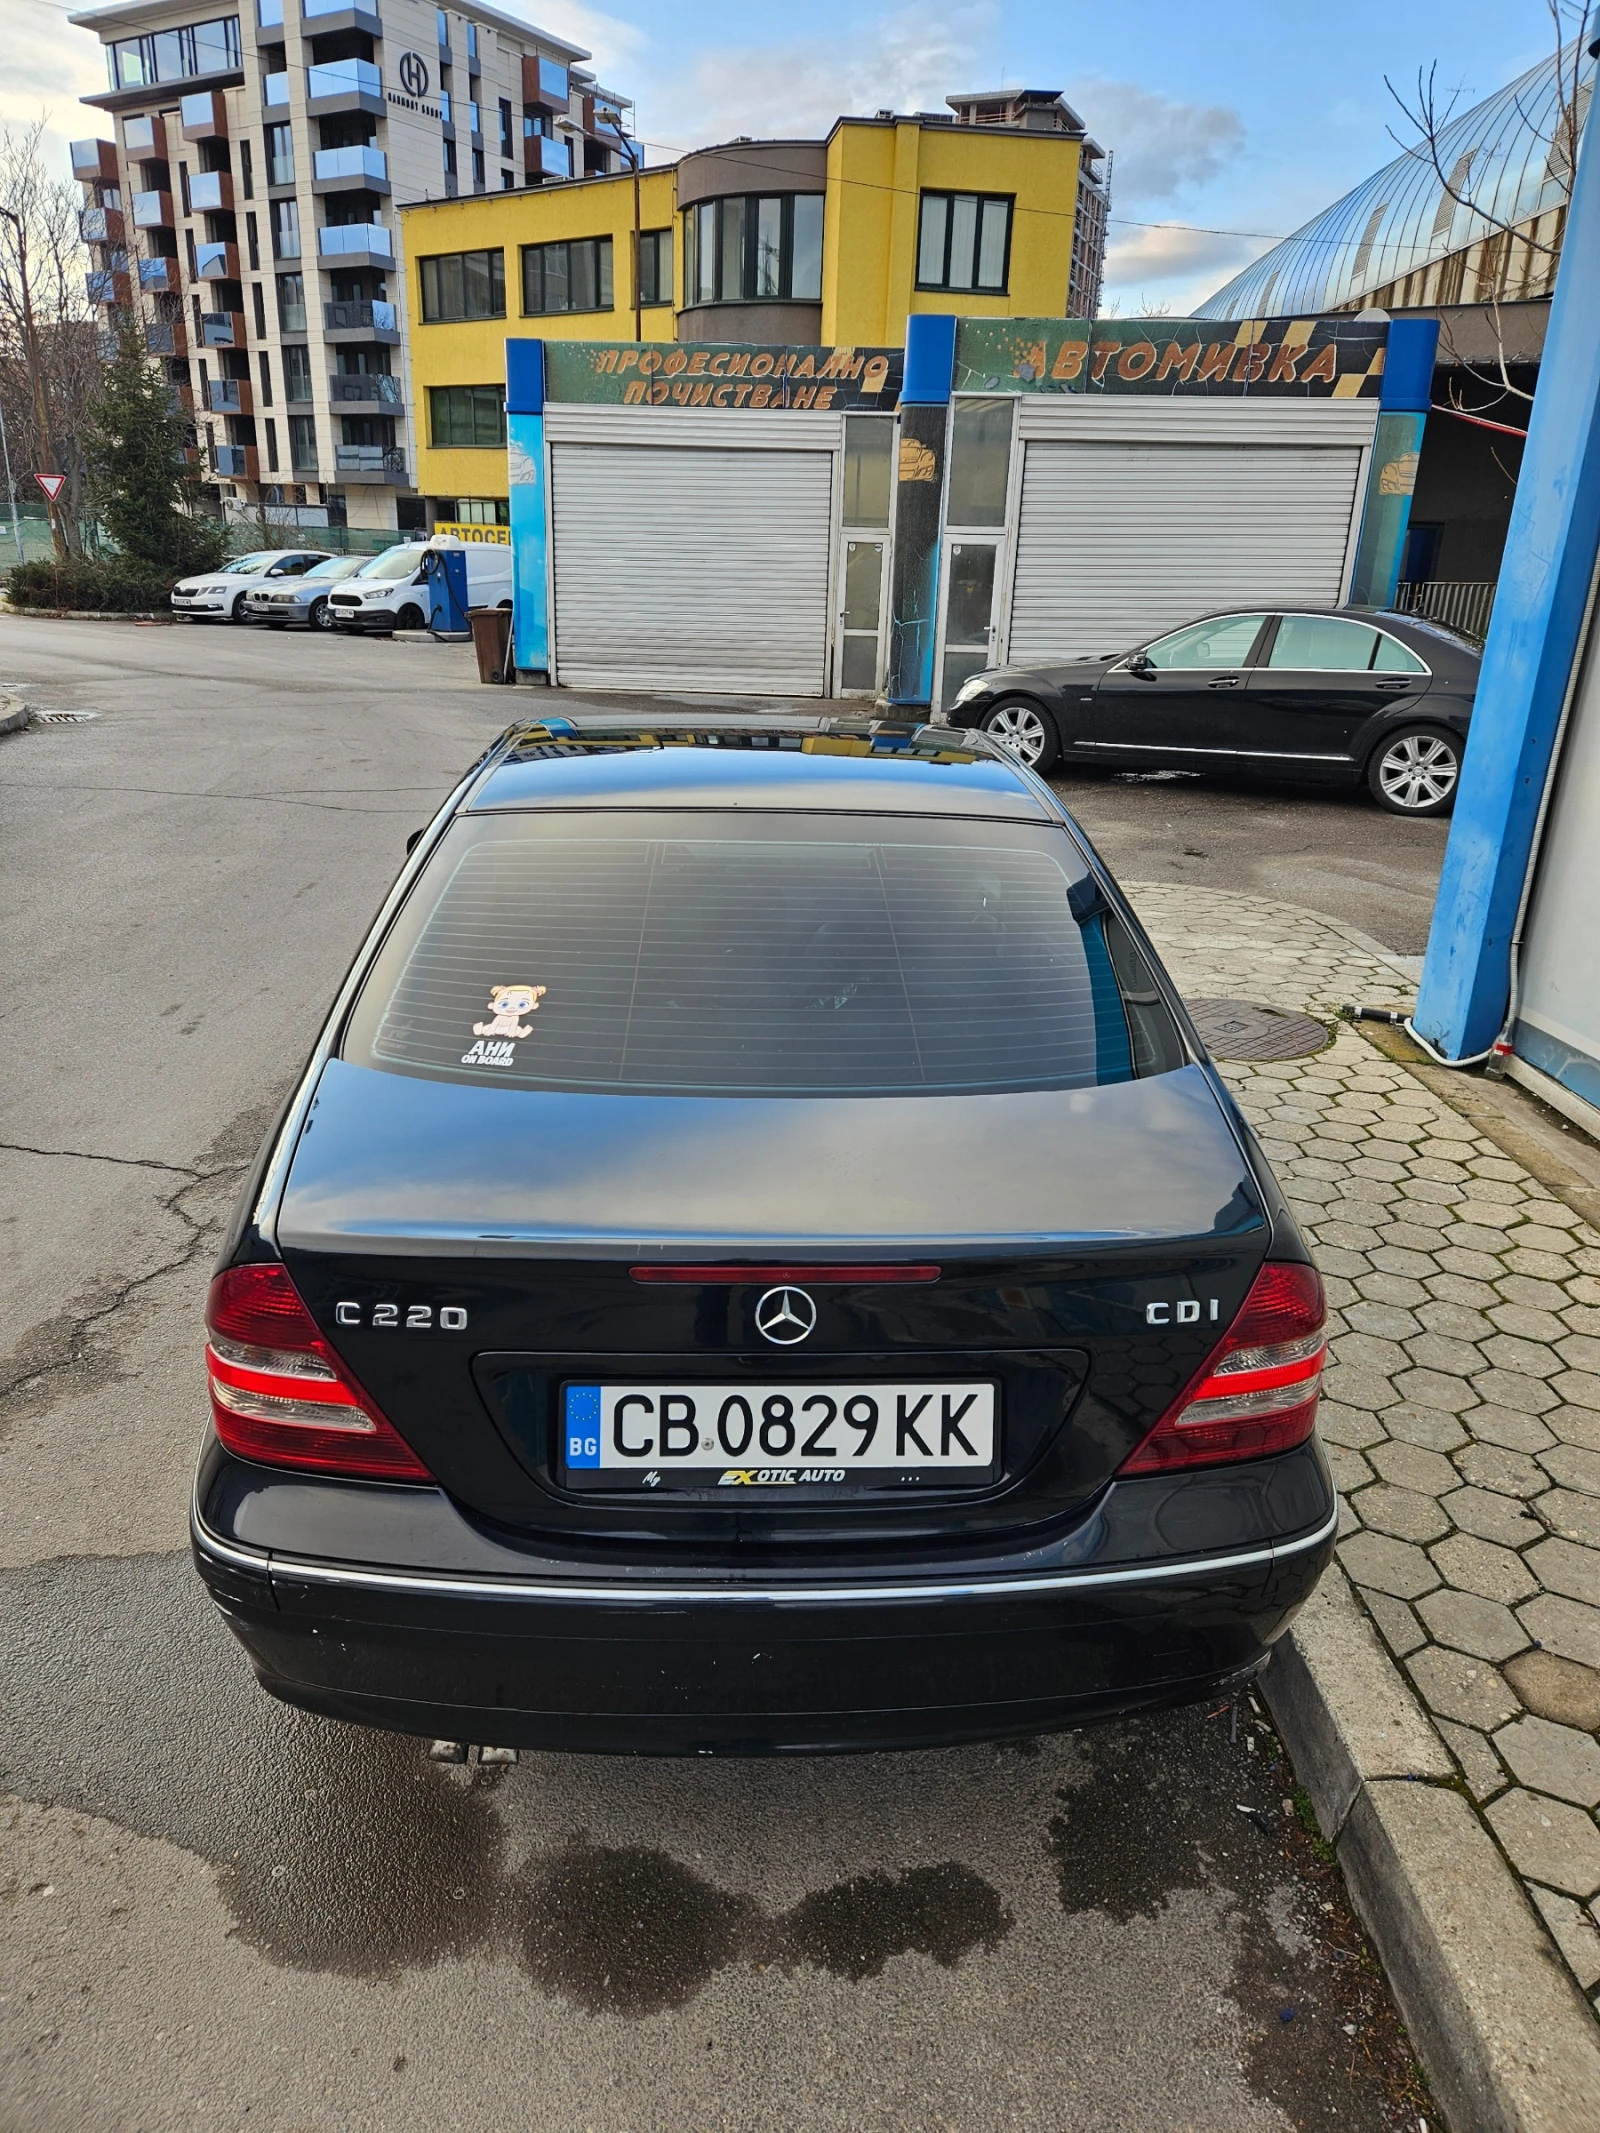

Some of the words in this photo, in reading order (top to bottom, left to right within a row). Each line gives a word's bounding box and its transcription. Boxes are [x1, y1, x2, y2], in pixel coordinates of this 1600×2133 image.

[596, 349, 889, 379] ПРОФЕСИОНАЛНО
[1013, 340, 1338, 383] АВТОМИВКА
[623, 381, 837, 410] ПОЧИСТВАНЕ
[440, 527, 511, 546] АВТОСЕ
[468, 1041, 516, 1057] АНИ
[461, 1055, 478, 1064] ON
[477, 1056, 514, 1066] BOARD
[1146, 1299, 1219, 1325] CDI
[569, 1438, 597, 1456] BG
[717, 1469, 797, 1485] EXOTIC
[799, 1469, 846, 1482] AUTO
